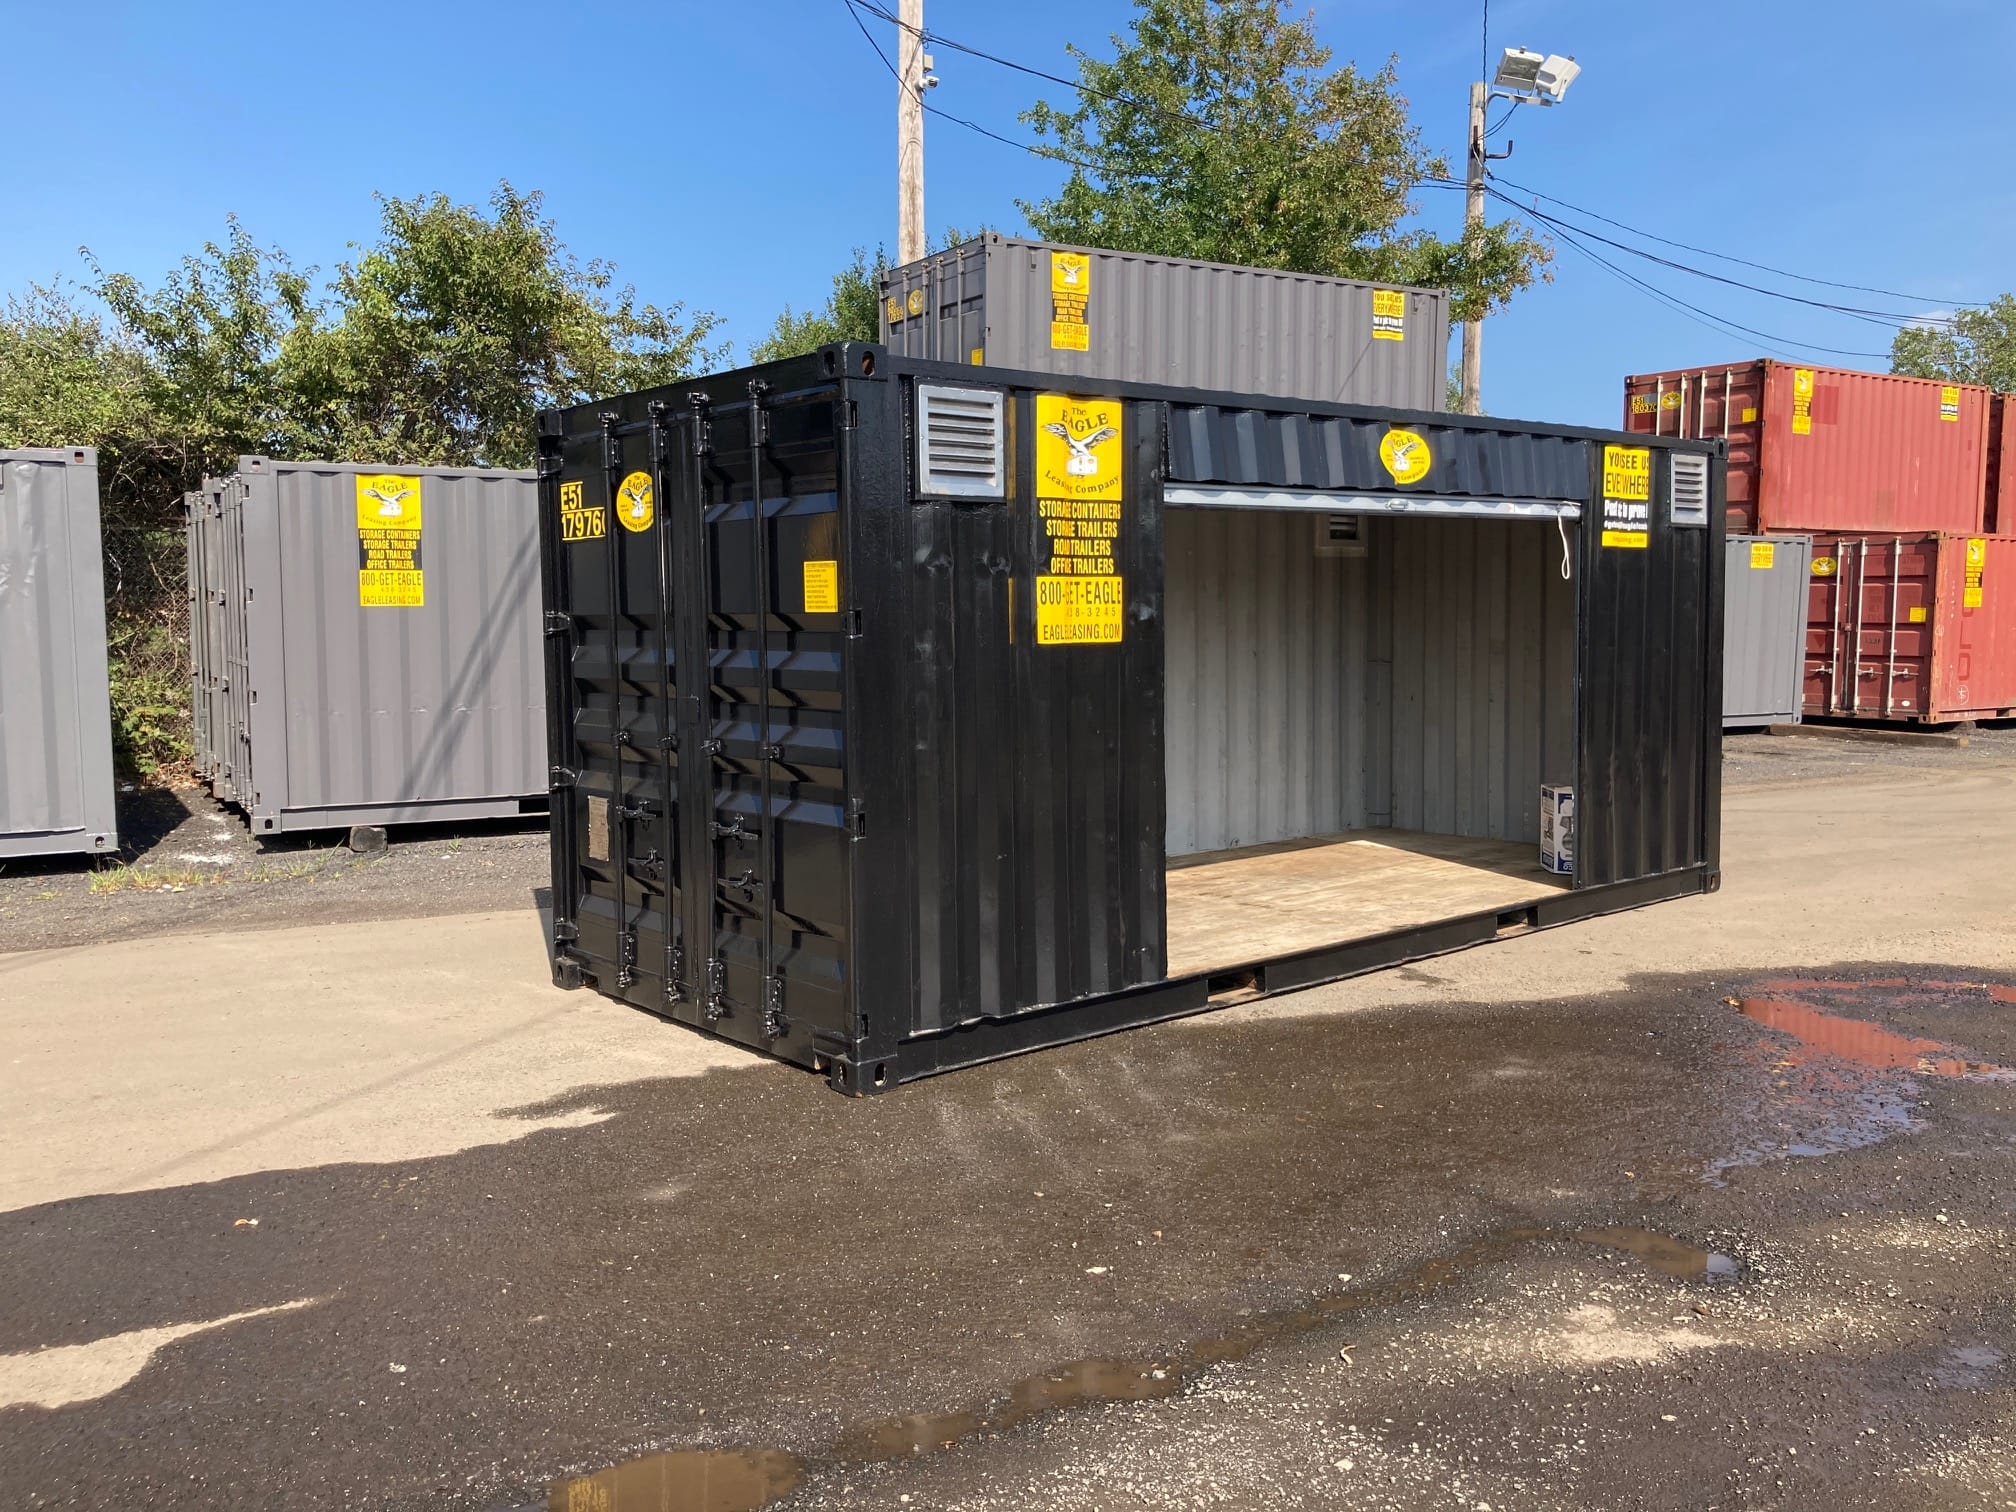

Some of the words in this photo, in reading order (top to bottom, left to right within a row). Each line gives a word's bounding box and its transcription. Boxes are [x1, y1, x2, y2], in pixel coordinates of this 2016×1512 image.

[1072, 407, 1087, 416] The
[1062, 409, 1109, 433] EAGLE
[372, 481, 408, 493] EAGLE
[1075, 475, 1119, 494] Company
[561, 484, 582, 511] E51
[1040, 500, 1071, 518] STORAE
[360, 529, 385, 539] STORAGE
[386, 530, 420, 540] CONTAINERS
[1077, 521, 1118, 538] TRAILERS
[363, 540, 390, 549] STORAGE
[391, 540, 416, 550] TRAILERS
[1070, 539, 1111, 556] TRAILERS
[366, 559, 387, 569] OFFICE
[1073, 558, 1114, 574] TRAILERS
